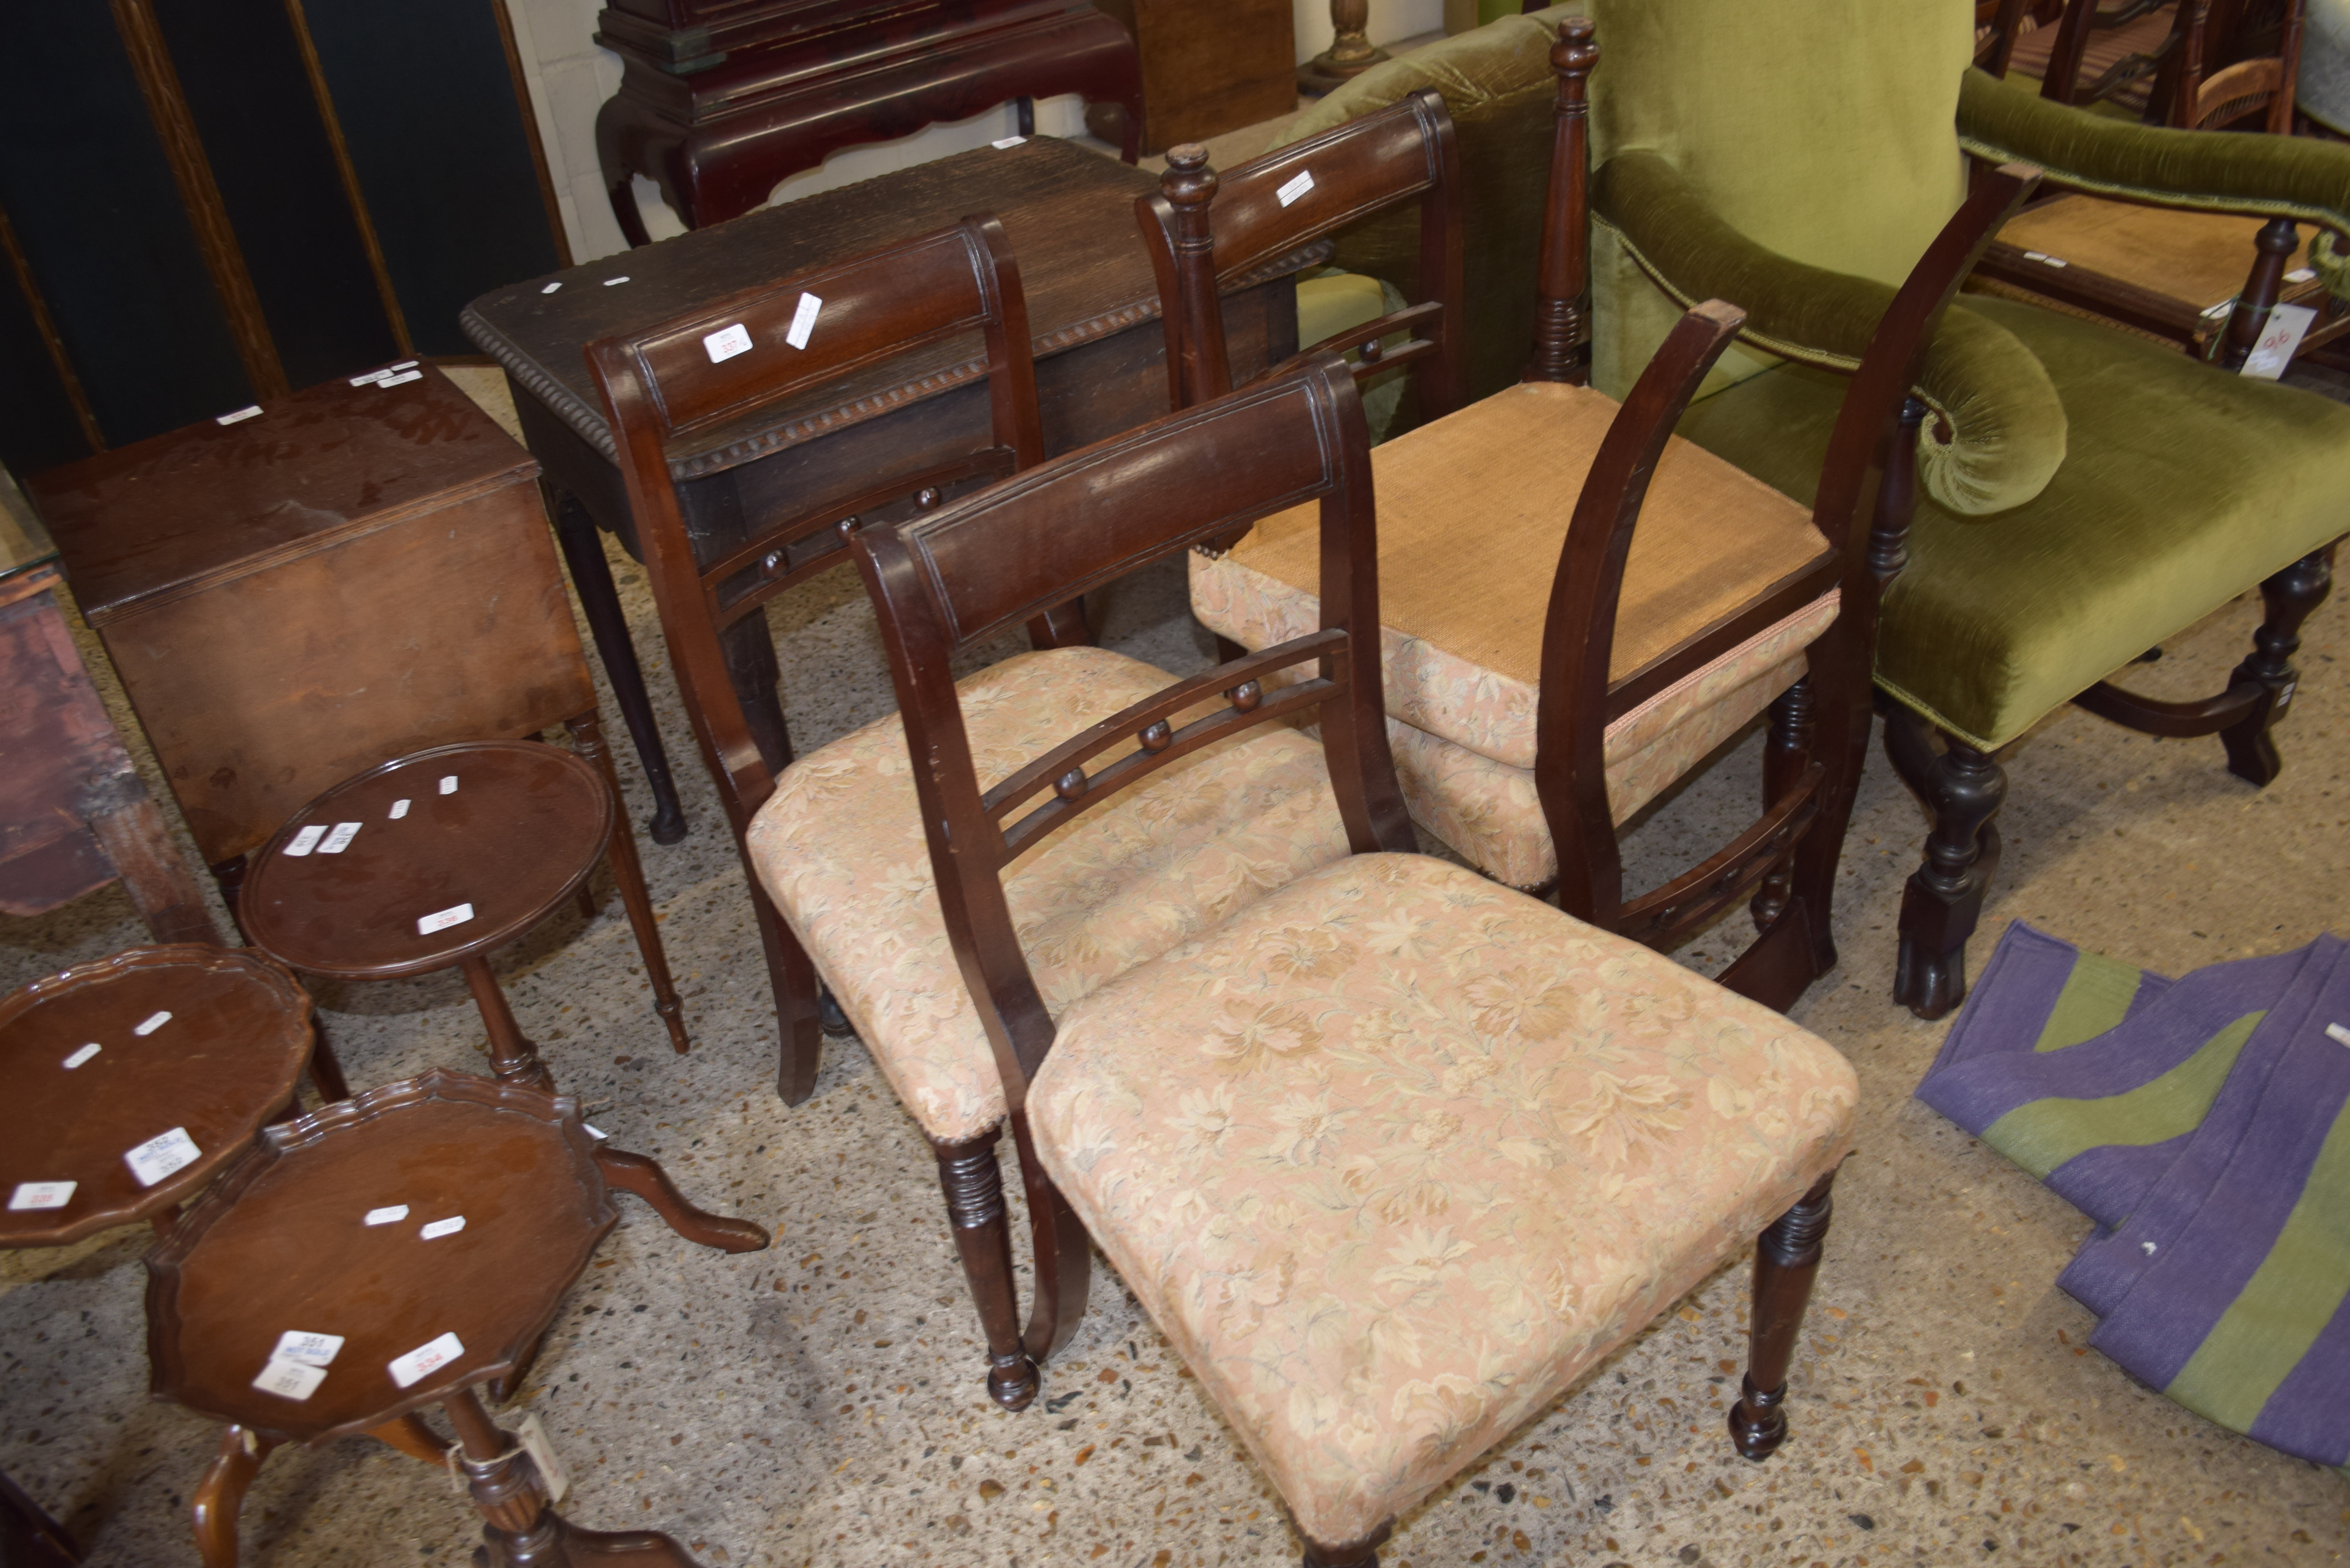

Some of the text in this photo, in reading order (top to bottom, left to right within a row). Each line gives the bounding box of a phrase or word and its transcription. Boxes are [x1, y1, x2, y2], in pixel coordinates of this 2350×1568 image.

[722, 340, 737, 353] 337
[437, 915, 458, 926] 336
[147, 1136, 169, 1151] 352
[160, 1157, 182, 1172] 352
[301, 1336, 325, 1347] 351
[417, 1353, 443, 1372] 334
